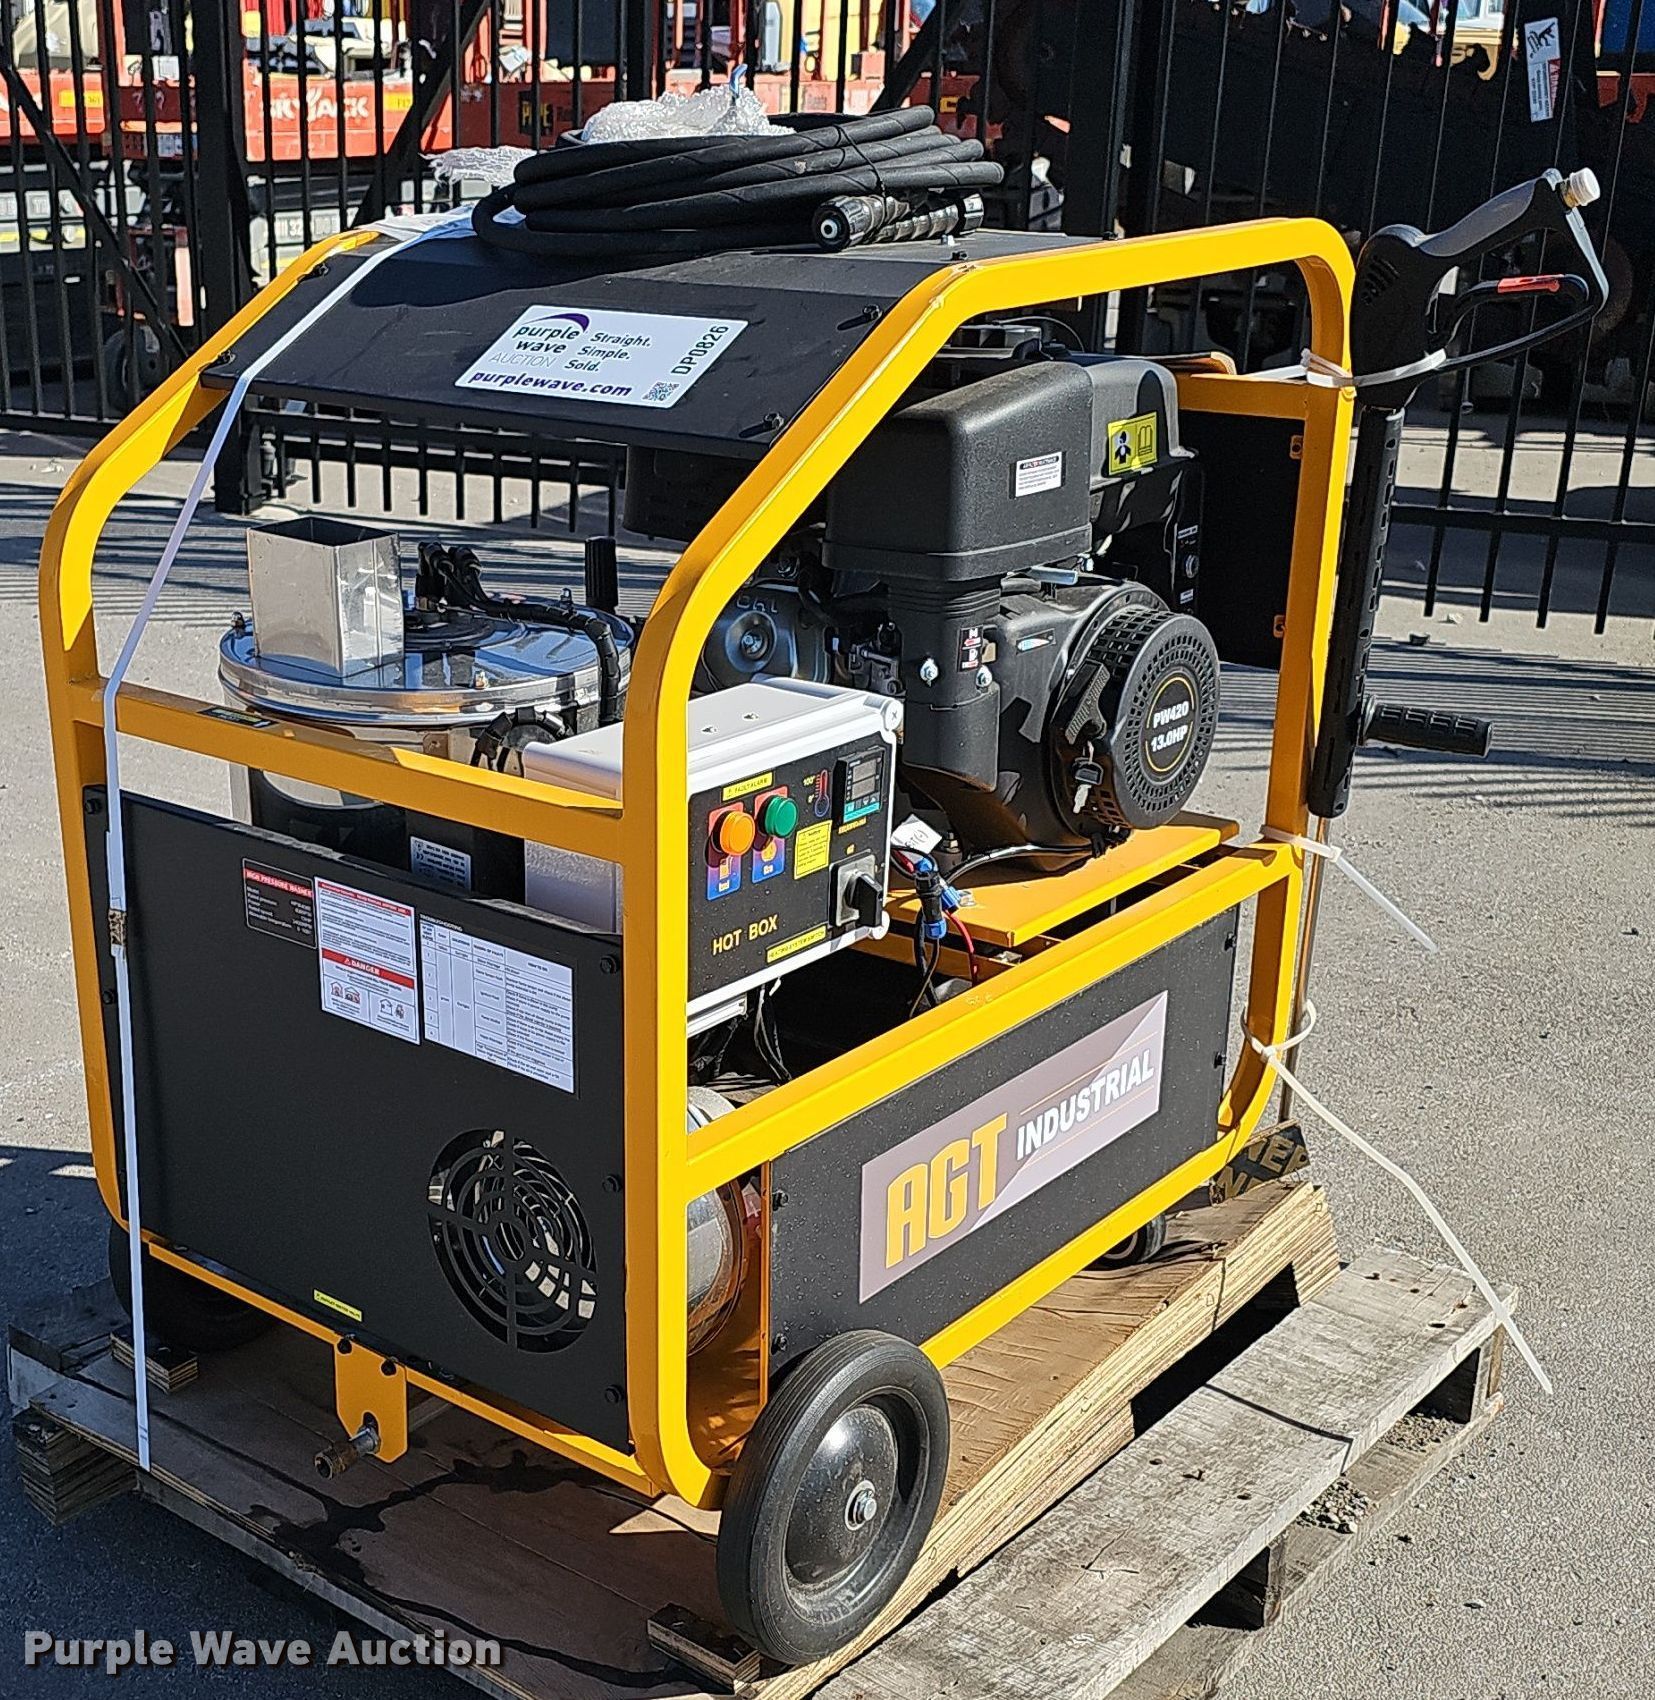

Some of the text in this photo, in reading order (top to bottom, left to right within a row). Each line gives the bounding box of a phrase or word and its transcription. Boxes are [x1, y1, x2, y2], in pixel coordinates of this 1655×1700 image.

[512, 322, 580, 341] purple
[590, 332, 652, 347] Straight.
[516, 340, 567, 355] wave
[577, 345, 631, 360] Simple.
[671, 325, 730, 376] DP0826
[488, 352, 558, 369] AUCTION
[564, 358, 600, 372] Sold.
[467, 370, 633, 398] purplewave.com
[1153, 701, 1189, 729] PW420
[1151, 724, 1188, 752] 13.0HP
[712, 914, 779, 955] HOT BOX
[351, 960, 380, 976] DANGER
[1016, 1048, 1155, 1161] INDUSTRIAL
[885, 1112, 1008, 1269] AGT
